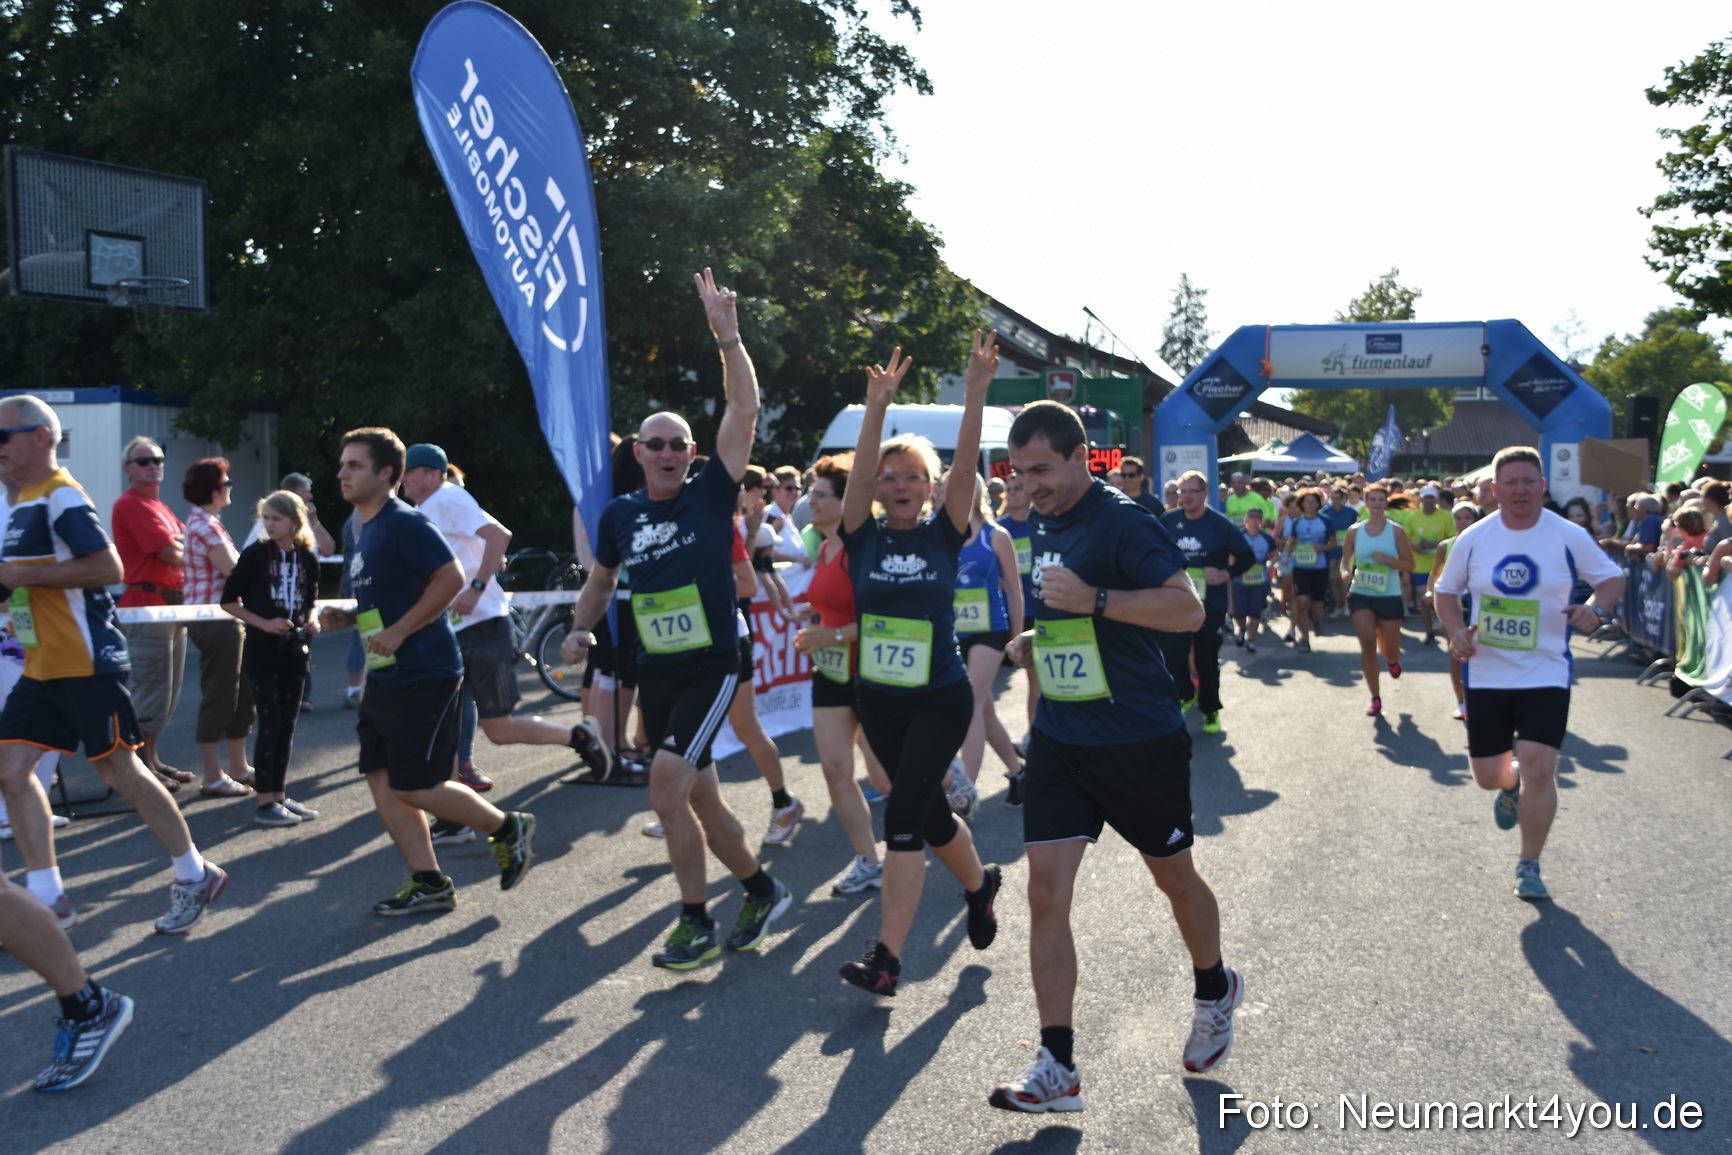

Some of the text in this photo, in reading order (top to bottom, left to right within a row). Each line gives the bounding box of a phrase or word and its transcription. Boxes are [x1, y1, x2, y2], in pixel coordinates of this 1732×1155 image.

[1352, 354, 1433, 370] firmenlauf
[1661, 440, 1692, 471] AOK
[1361, 572, 1385, 585] 1105
[650, 613, 693, 638] 170
[1483, 616, 1531, 637] 1486
[873, 643, 916, 668] 175
[1044, 653, 1088, 679] 172
